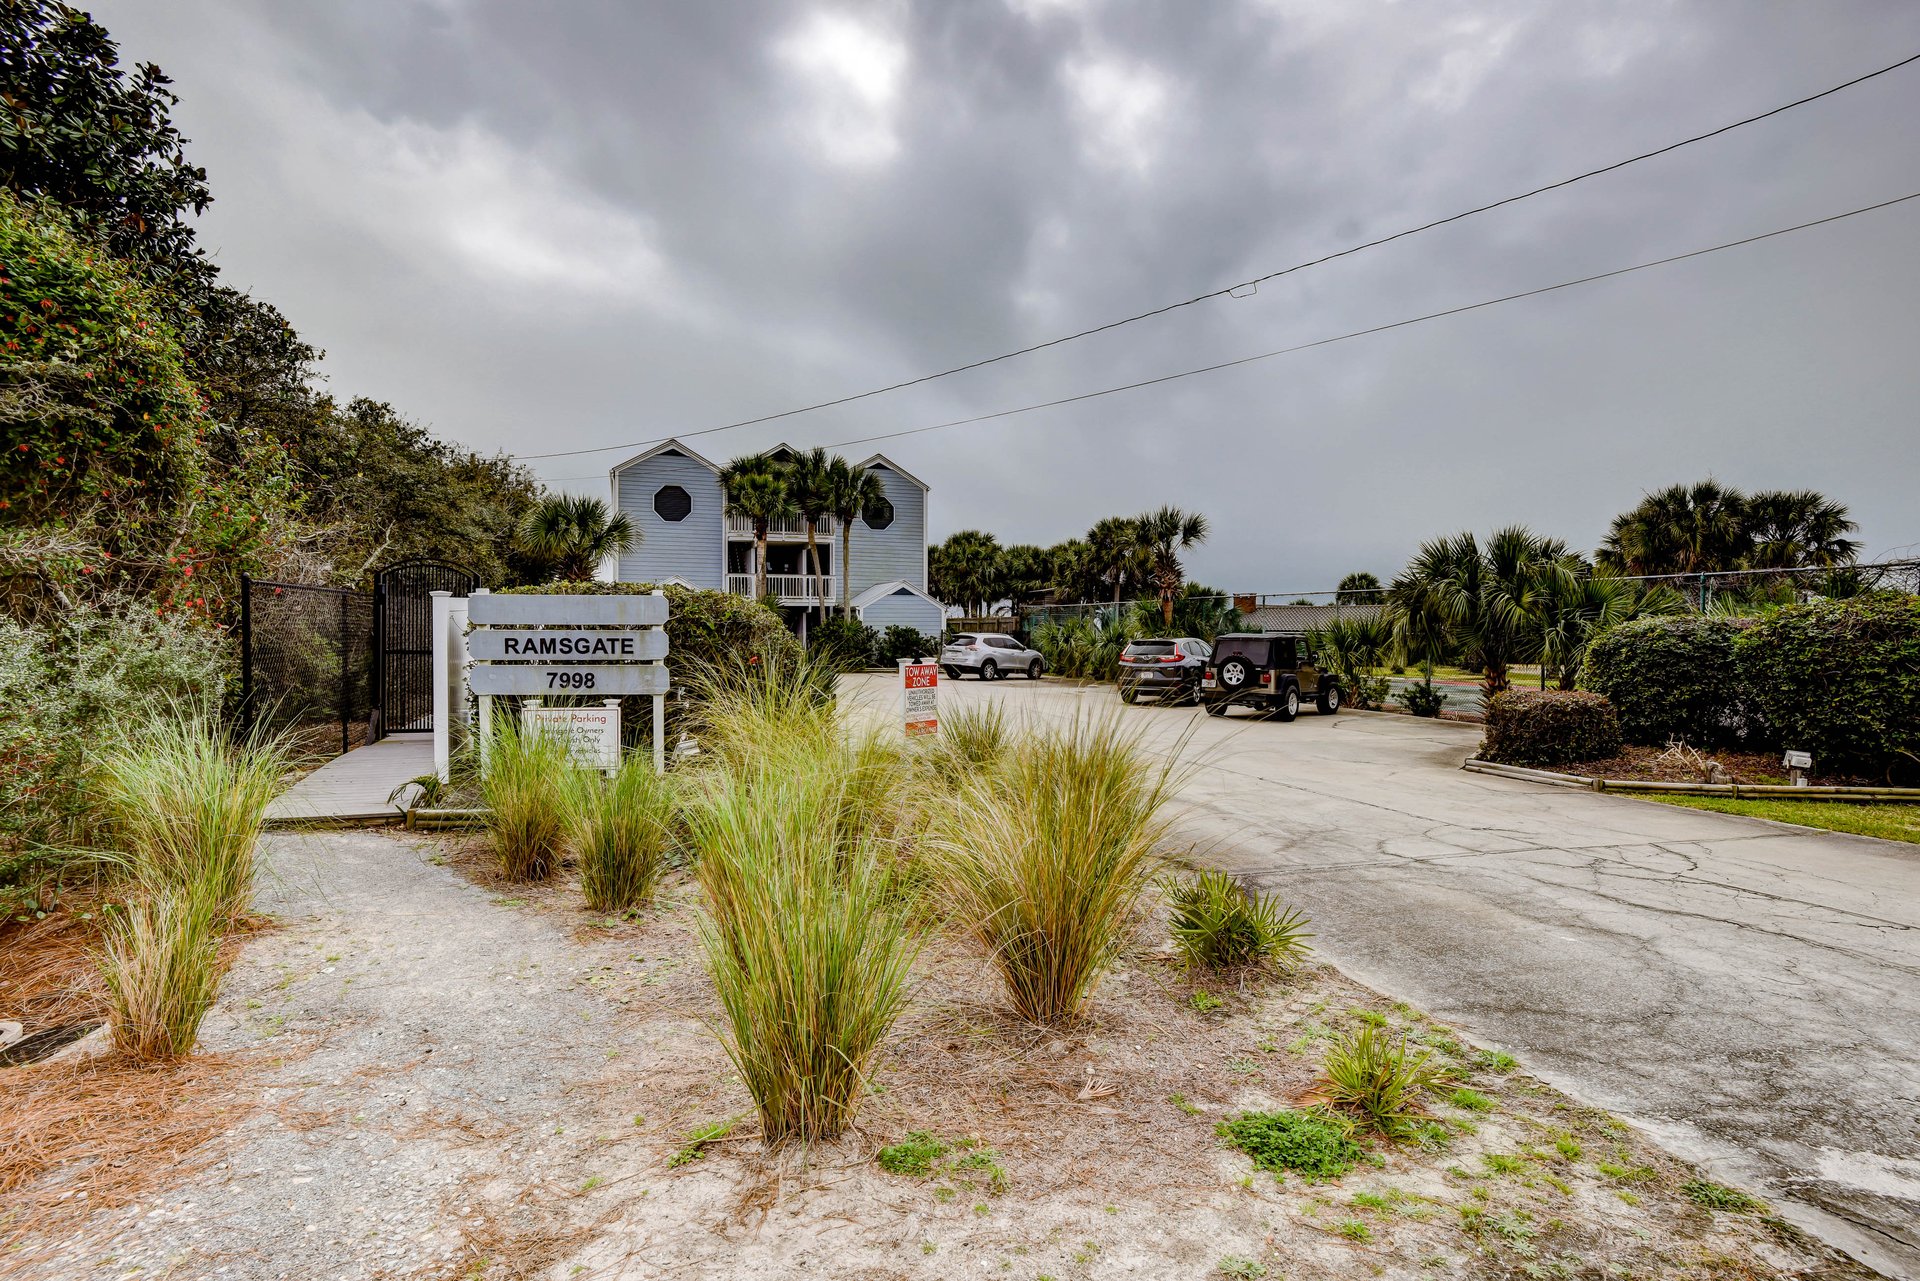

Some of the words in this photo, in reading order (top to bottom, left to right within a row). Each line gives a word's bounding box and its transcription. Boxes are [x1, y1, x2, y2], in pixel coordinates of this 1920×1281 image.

[504, 637, 634, 655] RAMSGATE
[906, 667, 919, 677] TOW
[920, 666, 937, 676] AWAY
[546, 672, 595, 689] 7998
[912, 677, 930, 687] ZONE
[535, 713, 567, 723] Private
[570, 713, 607, 725] Parking
[576, 726, 604, 734] Owners
[582, 735, 601, 744] Only
